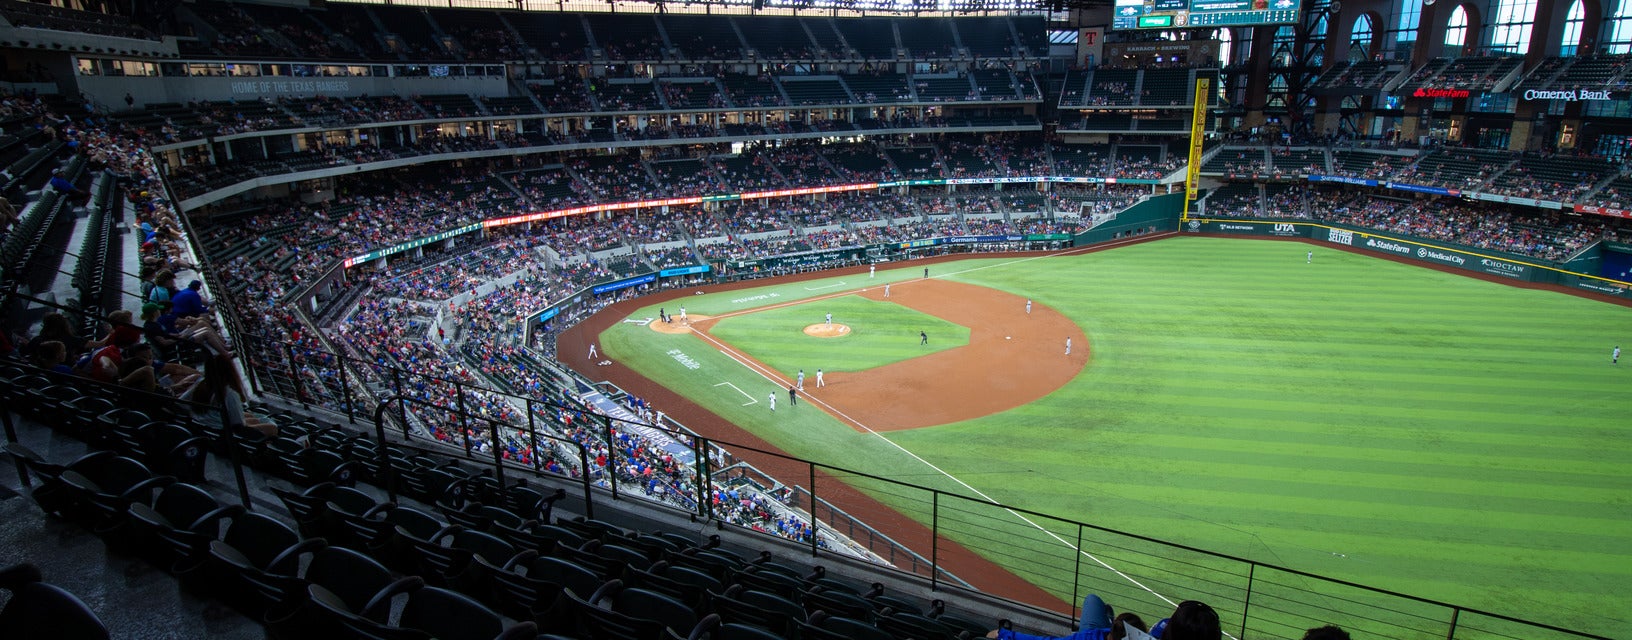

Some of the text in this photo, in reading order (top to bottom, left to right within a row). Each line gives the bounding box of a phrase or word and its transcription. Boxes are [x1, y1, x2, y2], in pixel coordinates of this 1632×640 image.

[1085, 31, 1097, 45] T
[231, 81, 350, 94] HOME OF THE TEXAS RANGERS
[1579, 90, 1612, 101] Bank
[1274, 223, 1295, 232] UTA
[951, 235, 978, 243] Germania
[1328, 232, 1352, 246] SELTZER
[1427, 251, 1465, 265] Medical City
[1484, 258, 1524, 273] CHOCTAW
